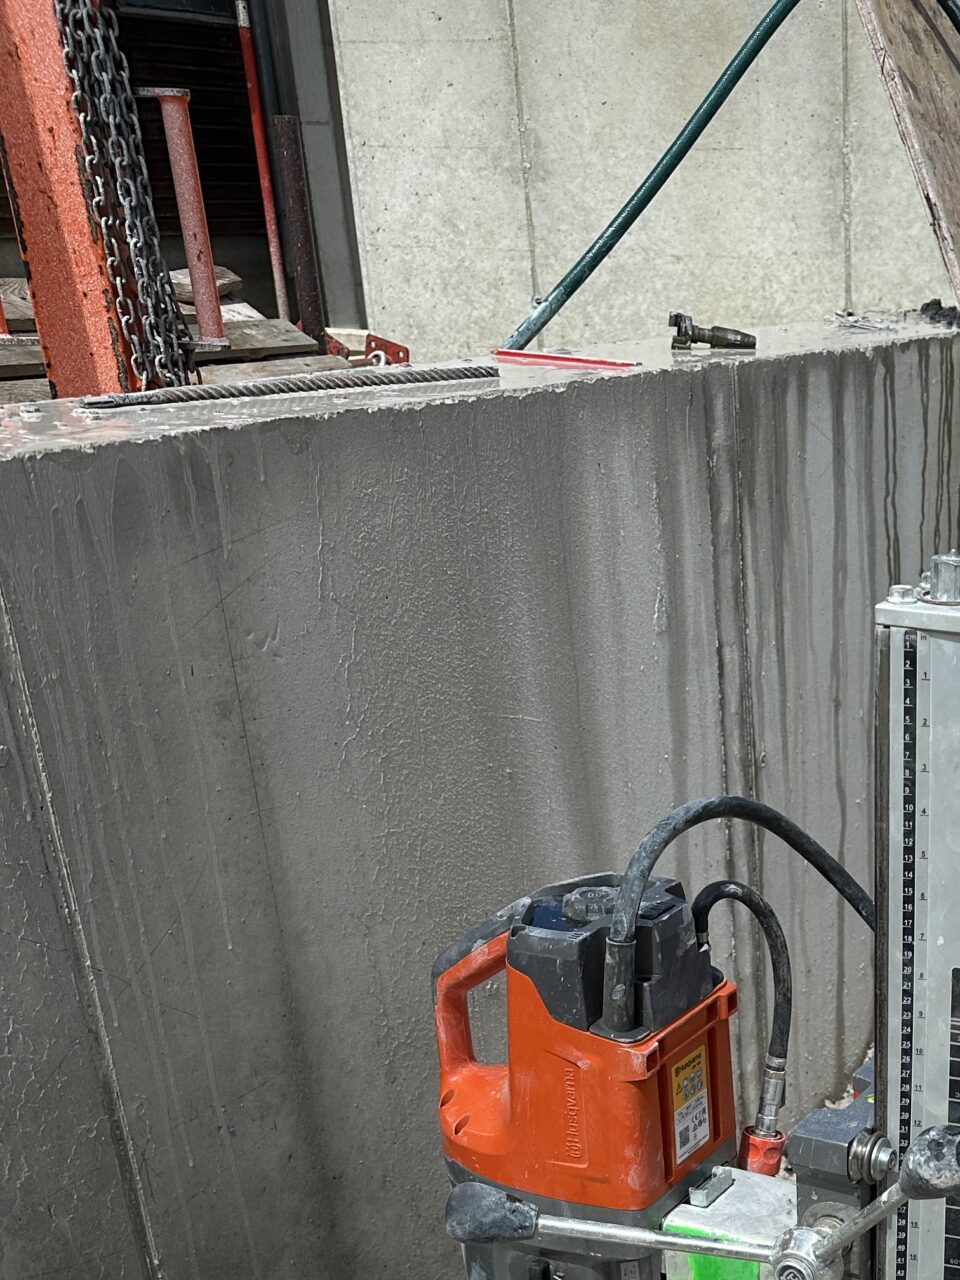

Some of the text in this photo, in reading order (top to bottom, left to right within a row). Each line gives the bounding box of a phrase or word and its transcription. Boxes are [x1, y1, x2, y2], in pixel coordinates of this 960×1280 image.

[904, 854, 913, 862] 13
[902, 1055, 911, 1063] 26
[564, 1067, 580, 1142] Husqvarna
[900, 1139, 909, 1147] 32
